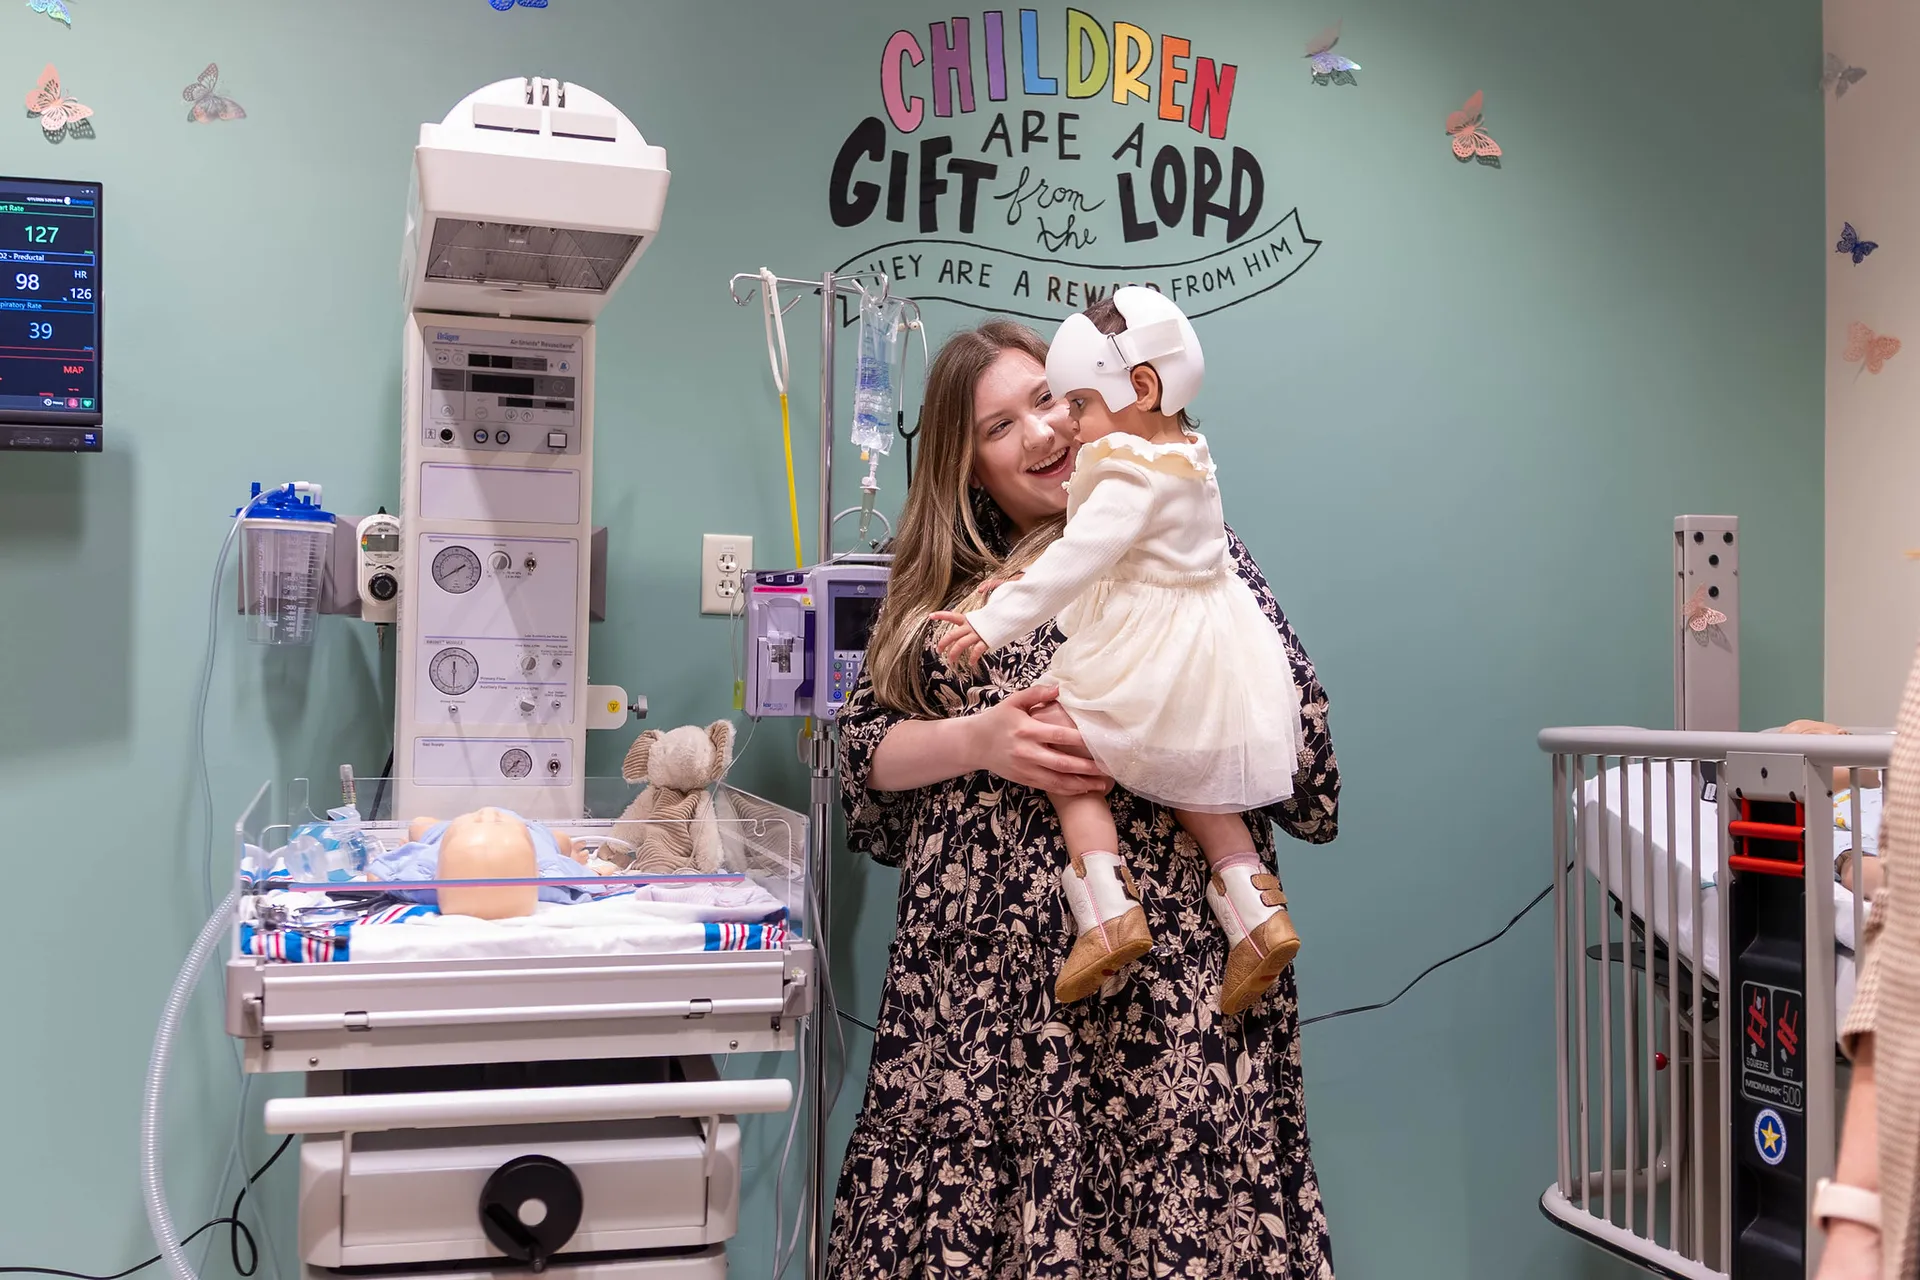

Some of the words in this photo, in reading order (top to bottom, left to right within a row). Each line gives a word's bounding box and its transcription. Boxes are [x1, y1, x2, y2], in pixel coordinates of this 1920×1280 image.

[881, 7, 1238, 139] CHILDREN
[980, 110, 1081, 160] ARE
[1112, 122, 1145, 168] A
[829, 117, 998, 234] GIFT
[994, 166, 1105, 225] from
[1117, 144, 1265, 243] LORD
[9, 204, 24, 212] Rate
[24, 225, 59, 243] 127
[1036, 216, 1097, 253] the
[13, 252, 44, 261] Preductal
[74, 270, 87, 279] HR
[938, 259, 993, 289] ARE
[1014, 270, 1031, 298] A
[1172, 269, 1235, 301] FROM
[1247, 236, 1293, 275] HIM
[15, 273, 40, 290] 98
[70, 288, 92, 299] 126
[27, 302, 42, 310] Rate
[29, 322, 53, 339] 39
[63, 365, 84, 374] MAP
[1745, 1057, 1769, 1071] SQUEEZE
[1782, 1067, 1794, 1078] LIFT
[1745, 1078, 1782, 1096] MIDMARK
[1782, 1085, 1802, 1107] 500
